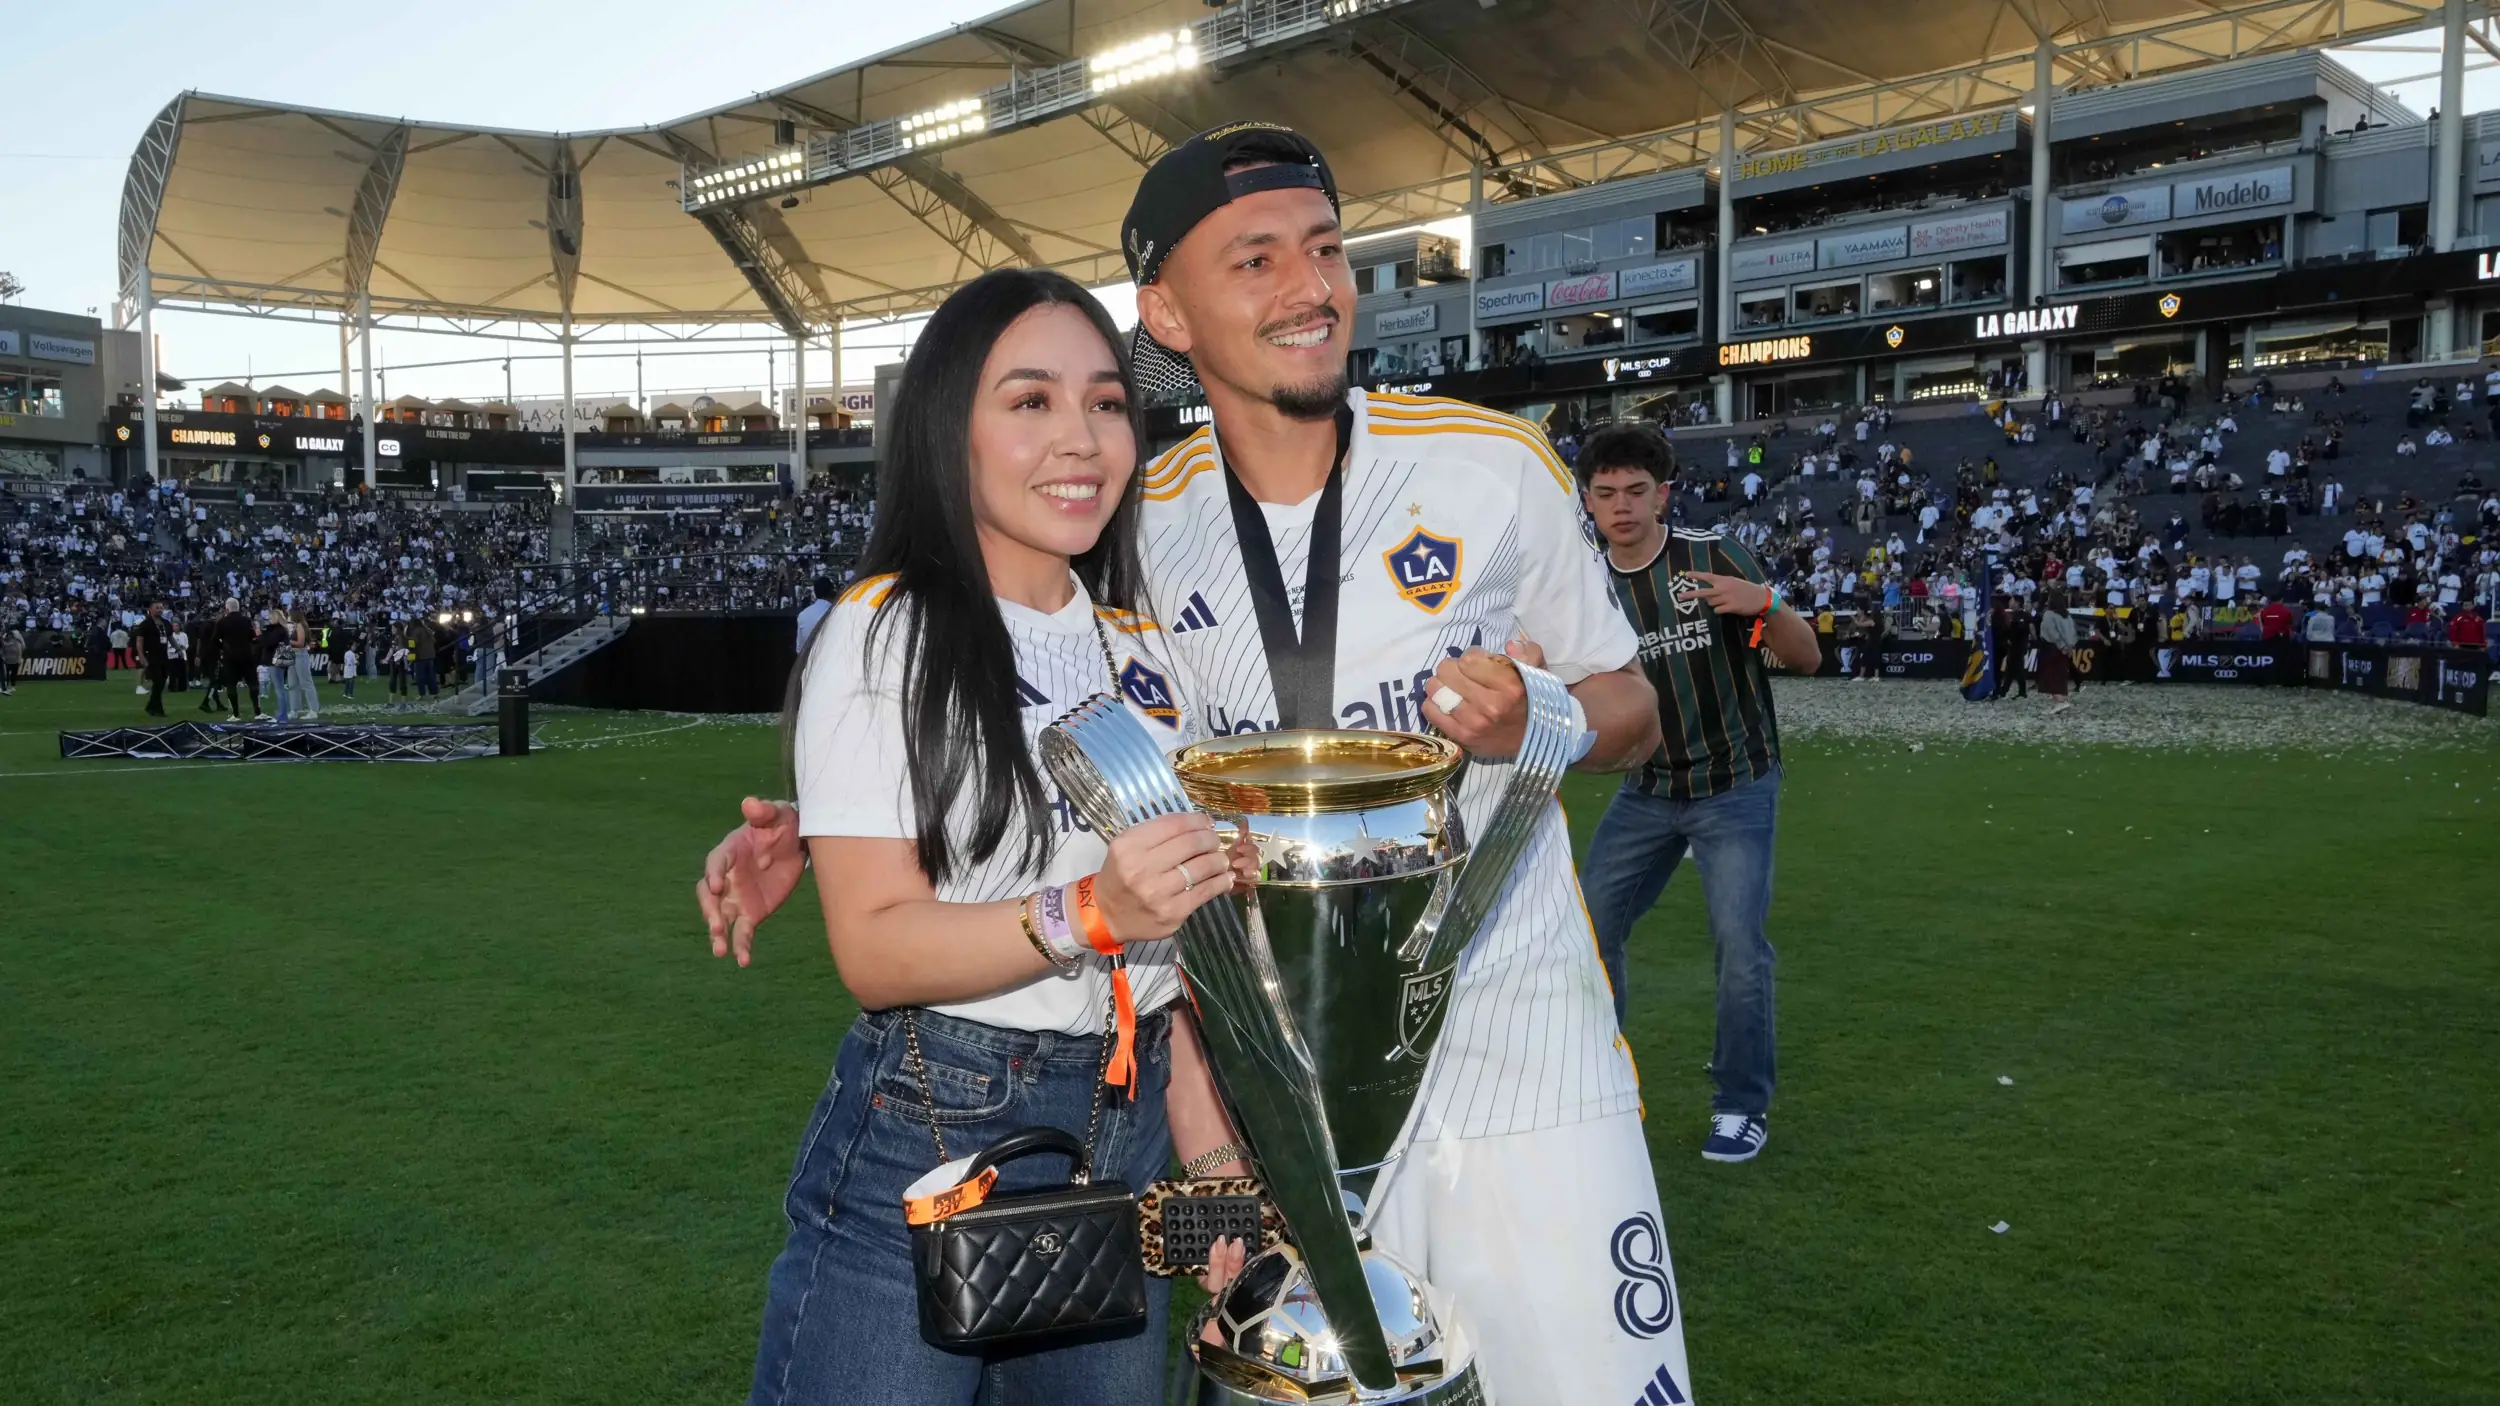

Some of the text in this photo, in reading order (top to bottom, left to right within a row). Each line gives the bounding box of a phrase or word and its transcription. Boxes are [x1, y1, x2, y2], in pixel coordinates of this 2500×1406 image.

[1740, 151, 1809, 181] HOME
[1859, 137, 1891, 158] LA
[1895, 114, 2002, 150] GALAXY
[2195, 179, 2270, 211] Modelo
[1935, 217, 2002, 236] Dignity Health
[1776, 251, 1811, 264] ULTRA
[1624, 267, 1668, 283] kinecta
[1478, 290, 1535, 311] Spectrum
[1379, 314, 1427, 332] Herbalife
[1977, 305, 2079, 338] LA GALAXY
[33, 340, 93, 357] Volkswagen
[1719, 336, 1811, 367] CHAMPIONS
[1620, 357, 1671, 371] MLS CUP
[1390, 382, 1432, 394] MLS CUP
[520, 409, 541, 423] LA
[1180, 407, 1193, 424] LA
[171, 429, 236, 446] CHAMPIONS
[296, 437, 344, 451] LA GALAXY
[381, 444, 397, 452] CC
[1403, 555, 1450, 584] LA
[1405, 581, 1454, 597] GALAXY
[1901, 653, 1934, 664] CUP
[2182, 654, 2274, 667] MLS CUP
[1130, 684, 1170, 705] LA
[1079, 877, 1096, 908] DAY
[1408, 976, 1442, 1004] MLS
[1610, 1211, 1674, 1340] 8
